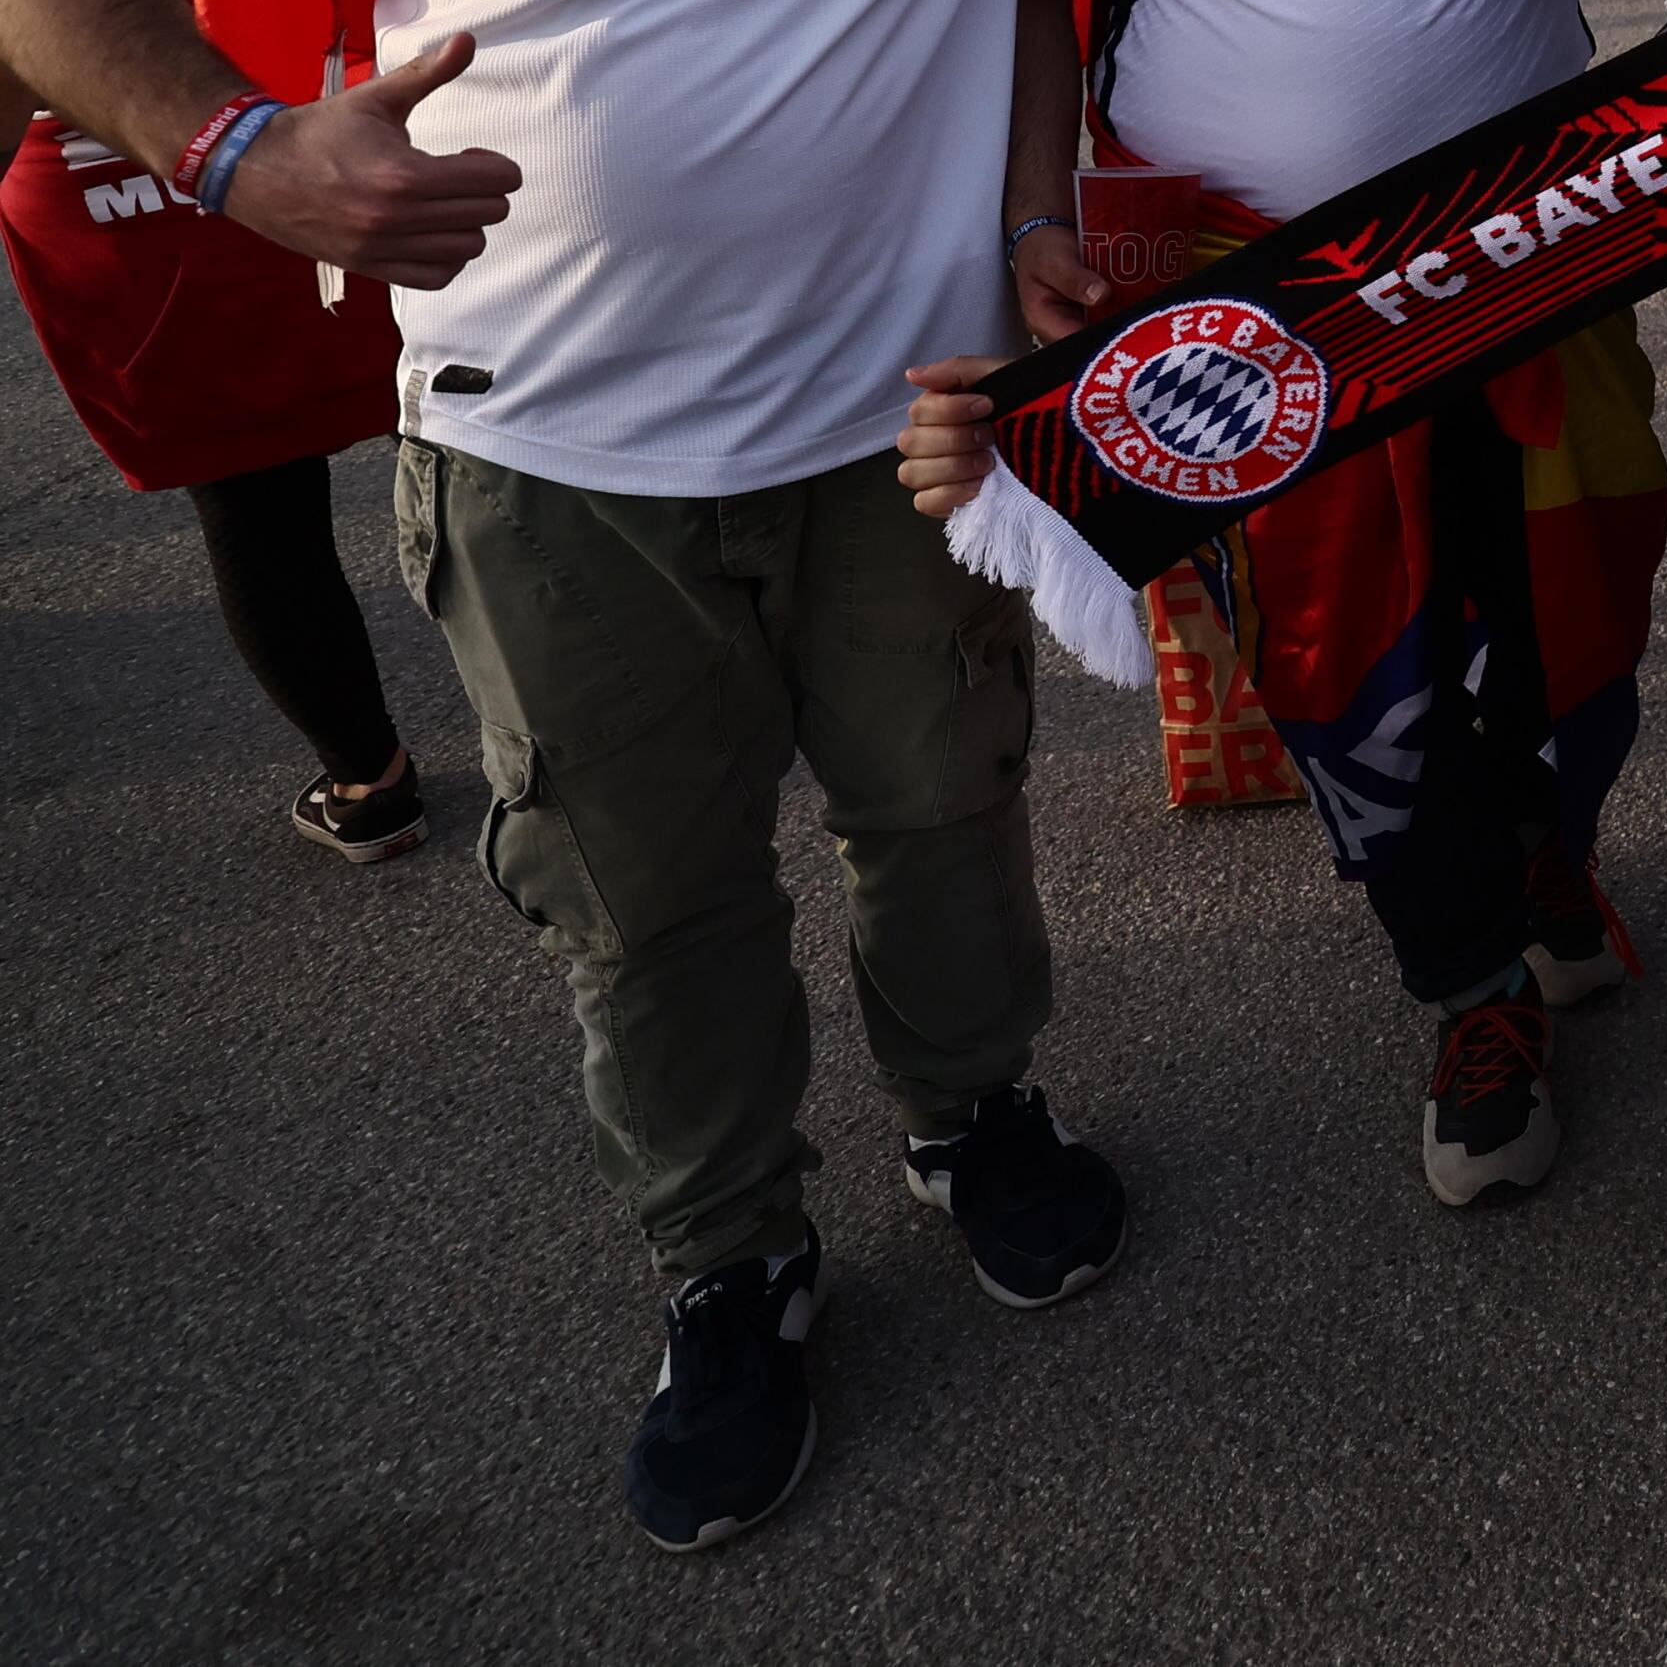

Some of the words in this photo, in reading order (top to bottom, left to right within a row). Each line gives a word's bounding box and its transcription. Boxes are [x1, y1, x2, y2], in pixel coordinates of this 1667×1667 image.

[190, 105, 240, 153] Madrid
[1355, 250, 1468, 325] FC
[1170, 310, 1224, 343] FC
[1230, 318, 1318, 461] BAYERN
